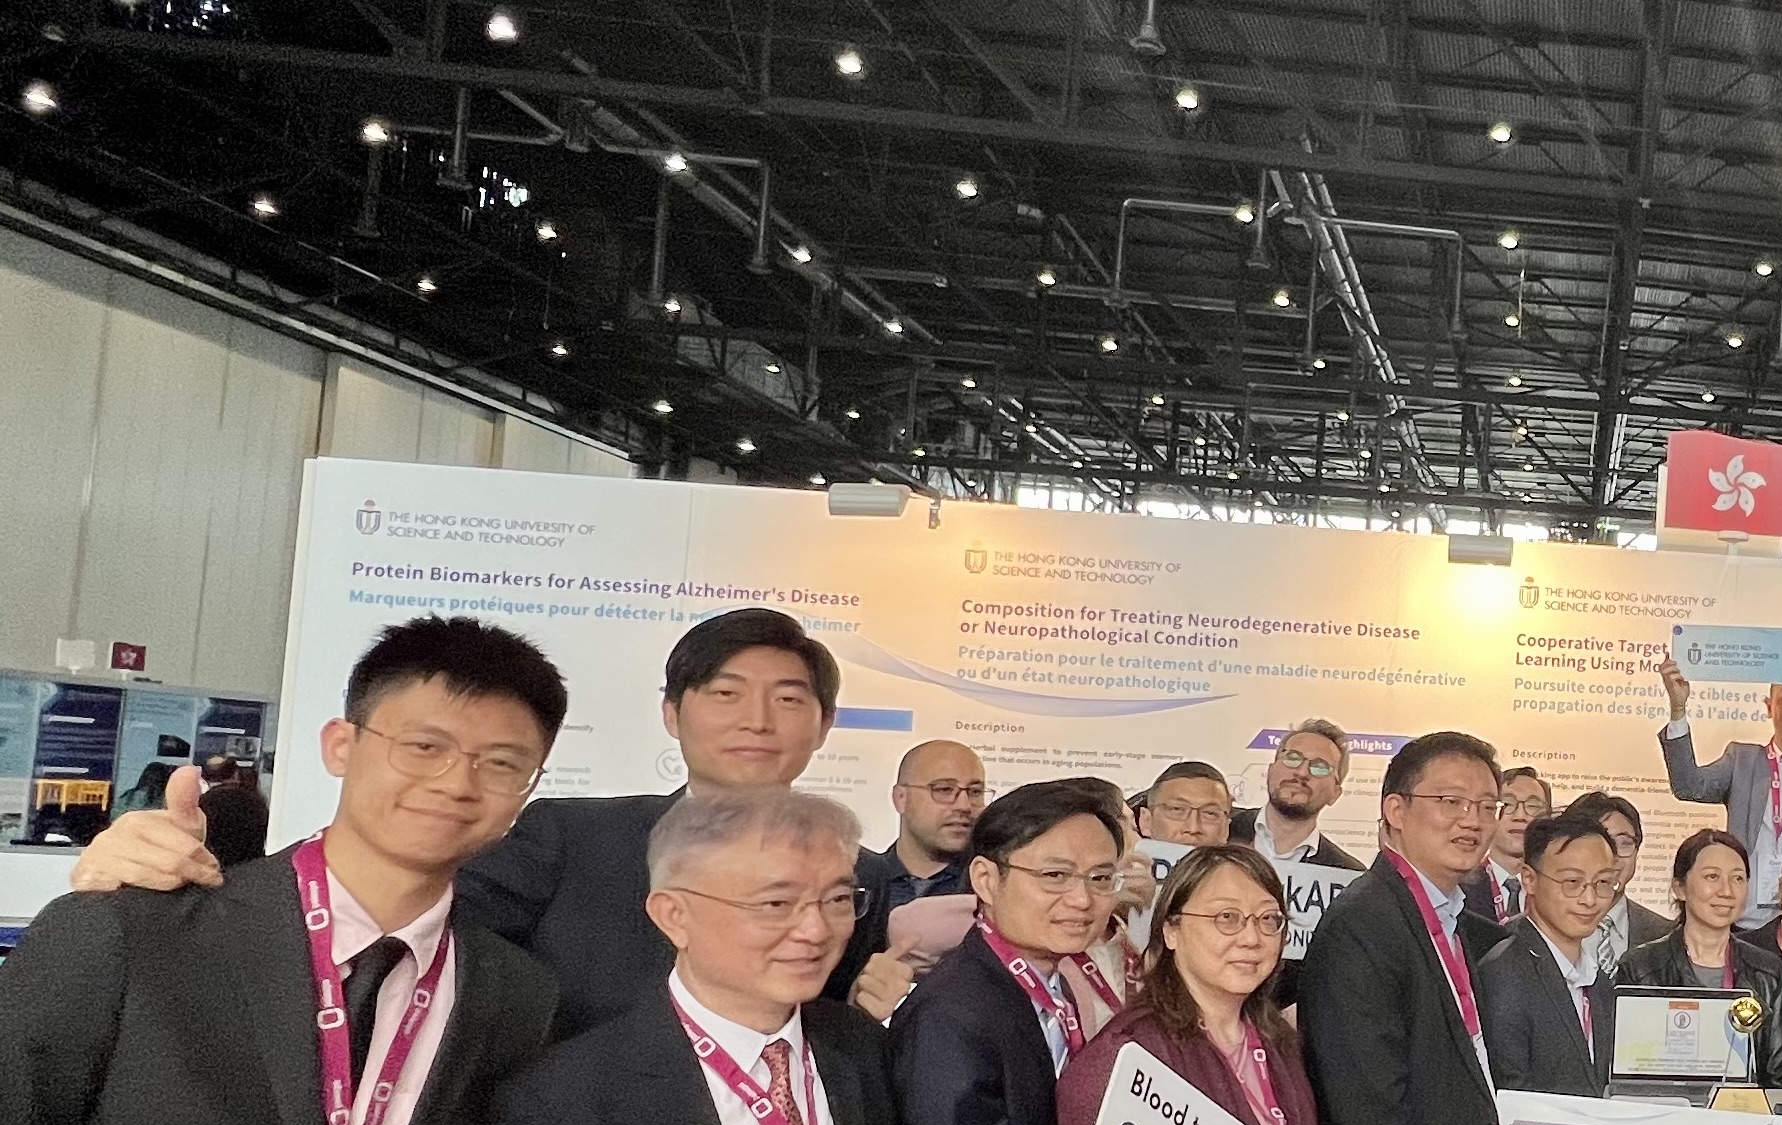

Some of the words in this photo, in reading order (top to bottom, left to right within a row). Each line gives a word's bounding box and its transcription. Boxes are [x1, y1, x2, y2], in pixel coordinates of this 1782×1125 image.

[389, 513, 410, 522] THE
[415, 515, 456, 525] HONG
[461, 518, 500, 528] KONG
[505, 521, 575, 532] UNIVERSITY
[578, 525, 595, 534] OF
[387, 527, 440, 538] SCIENCE
[444, 531, 474, 540] AND
[478, 533, 565, 546] TECHNOLOGY
[995, 553, 1014, 561] THE
[1018, 554, 1055, 564] HONG
[1059, 556, 1096, 567] KONG
[1099, 560, 1162, 570] UNIVERSITY
[1165, 564, 1181, 572] OF
[353, 562, 423, 579] Protein
[431, 567, 541, 587] Biomarkers
[548, 573, 575, 589] for
[580, 577, 671, 599] Assessing
[676, 582, 785, 601] Alzheimer's
[792, 589, 859, 606] Disease
[993, 566, 1041, 577] SCIENCE
[1044, 570, 1071, 578] AND
[1075, 572, 1154, 584] TECHNOLOGY
[349, 590, 445, 612] Marqueurs
[450, 596, 544, 615] protéiques
[548, 605, 590, 617] pour
[594, 603, 665, 621] détécter
[670, 608, 685, 621] la
[1545, 588, 1564, 596] THE
[1567, 590, 1601, 599] HONG
[1605, 593, 1638, 601] KONG
[1641, 595, 1699, 605] UNIVERSITY
[963, 600, 1074, 619] Composition
[1081, 606, 1104, 621] for
[1111, 609, 1182, 629] Treating
[1189, 614, 1351, 635] Neurodegenerative
[1358, 623, 1419, 640] Disease
[1544, 602, 1588, 611] SCIENCE
[1591, 605, 1616, 613] AND
[1619, 606, 1692, 618] TECHNOLOGY
[961, 623, 979, 633] or
[985, 621, 1148, 645] Neuropathological
[1154, 631, 1237, 648] Condition
[1517, 634, 1613, 651] Cooperative
[1618, 641, 1668, 654] Target
[959, 646, 1053, 663] Préparation
[1059, 654, 1096, 667] pour
[1101, 653, 1114, 667] le
[1119, 656, 1203, 672] traitement
[1208, 660, 1252, 674] d'une
[1256, 664, 1318, 678] maladie
[1322, 667, 1466, 686] neurodégénérative
[1516, 652, 1586, 672] Learning
[1591, 656, 1635, 675] Using
[956, 669, 976, 684] ou
[981, 667, 1017, 685] d'un
[1022, 669, 1053, 683] état
[1058, 674, 1210, 693] neuropathologique
[1515, 678, 1584, 693] Poursuite
[1589, 682, 1666, 698] coopérativ
[1700, 687, 1740, 702] cibles
[1744, 690, 1757, 702] et
[1513, 699, 1603, 713] propagation
[1607, 700, 1632, 714] des
[1696, 704, 1704, 718] à
[1708, 705, 1747, 722] l'aide
[955, 720, 1025, 734] Description
[1512, 748, 1576, 761] Description
